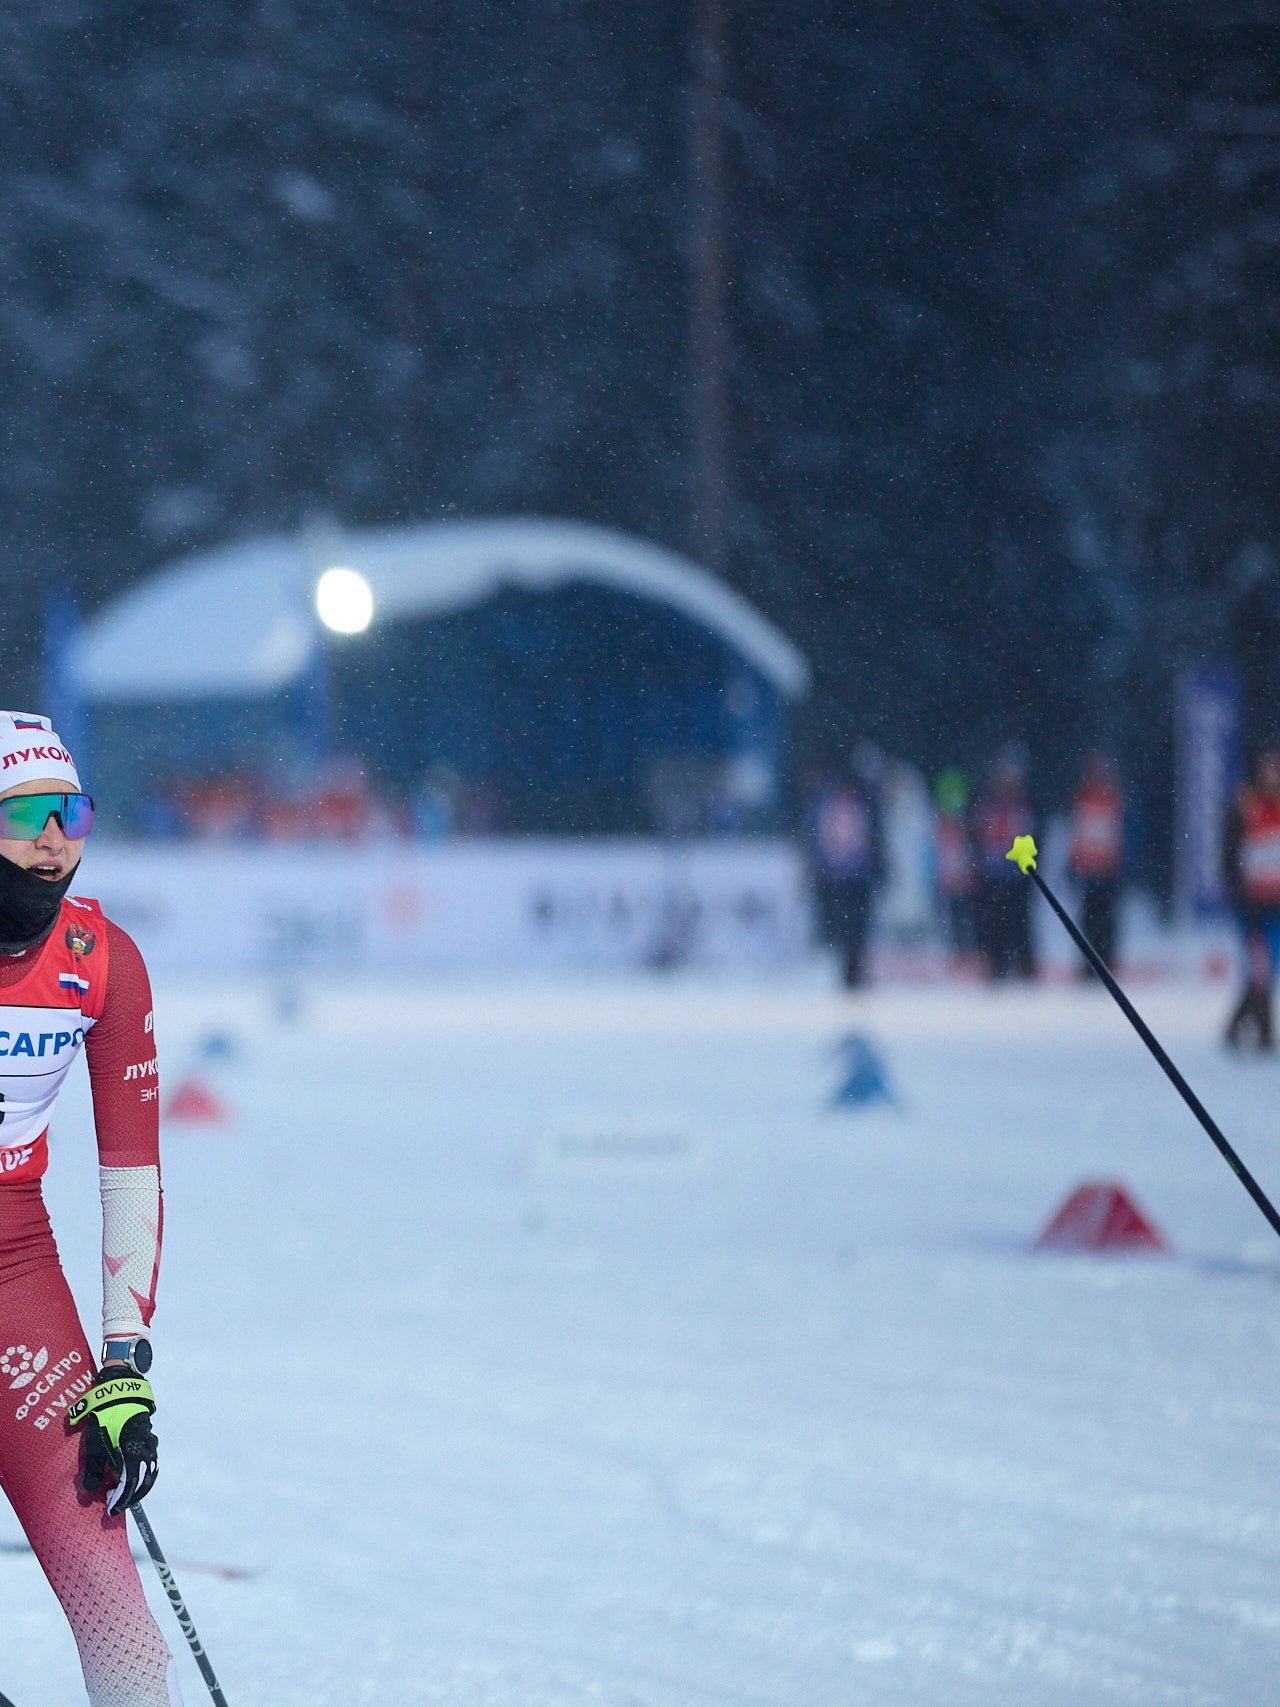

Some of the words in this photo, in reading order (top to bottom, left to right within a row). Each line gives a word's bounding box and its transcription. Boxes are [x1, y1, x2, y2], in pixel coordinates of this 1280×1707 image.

[2, 746, 76, 769] ЛУКОЙ
[15, 1350, 82, 1420] ФОСАГРО
[33, 1370, 96, 1431] BIVIUM
